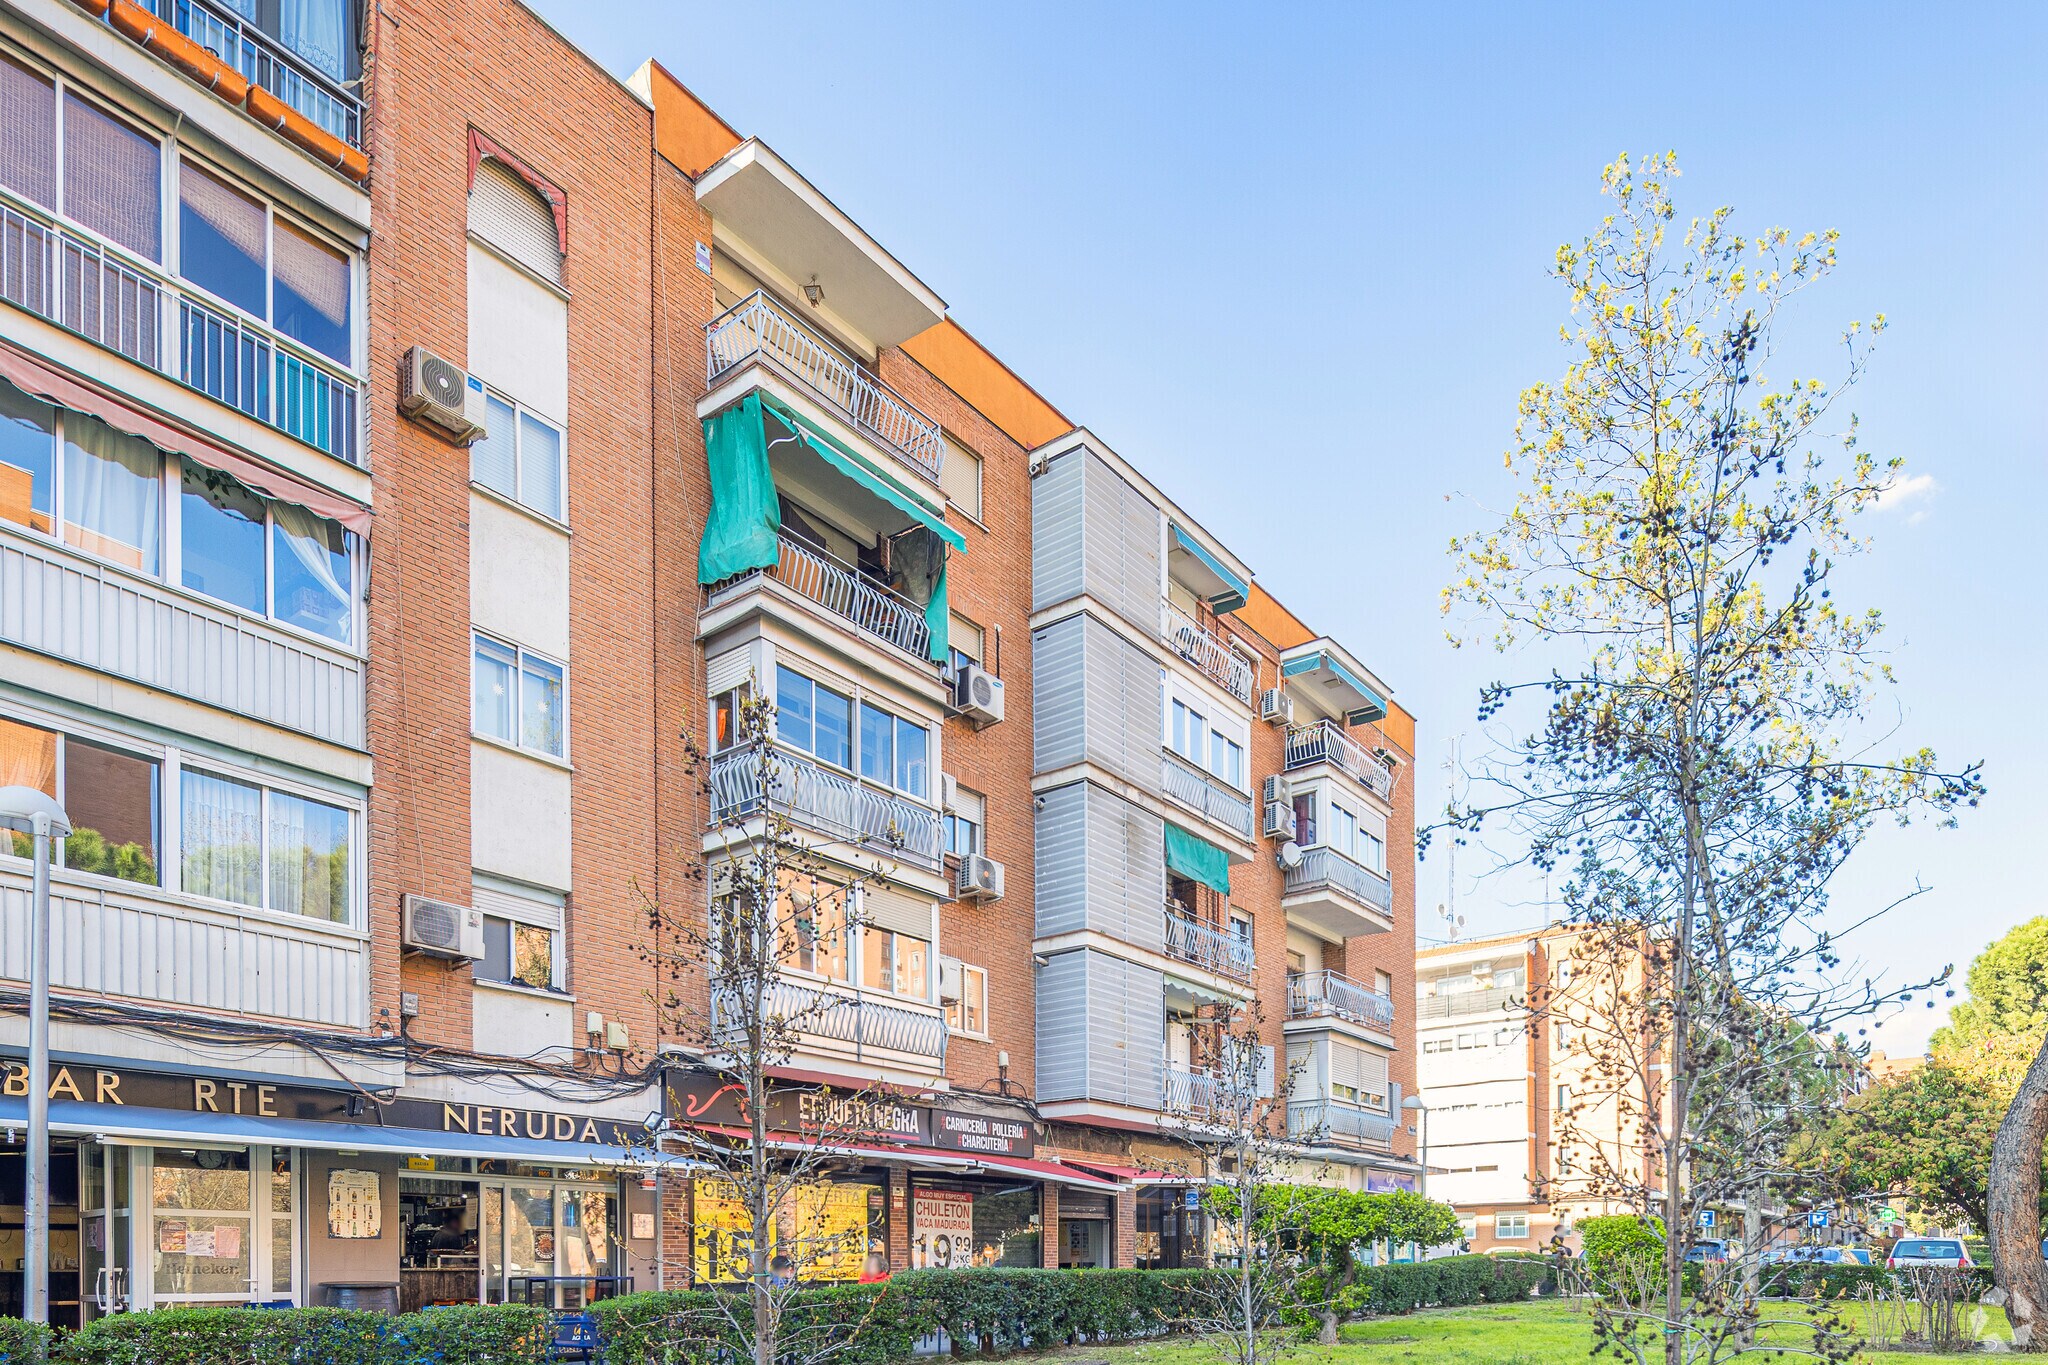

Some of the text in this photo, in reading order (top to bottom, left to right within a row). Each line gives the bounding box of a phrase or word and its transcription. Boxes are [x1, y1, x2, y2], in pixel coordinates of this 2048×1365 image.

[3, 1060, 602, 1144] BAR RTE NERUDA
[874, 1104, 920, 1134] NEGRA
[919, 1190, 967, 1201] ALGO MUY ESPECIAL
[915, 1199, 970, 1219] CHULETÓN
[915, 1217, 971, 1231] VACA MADURADA
